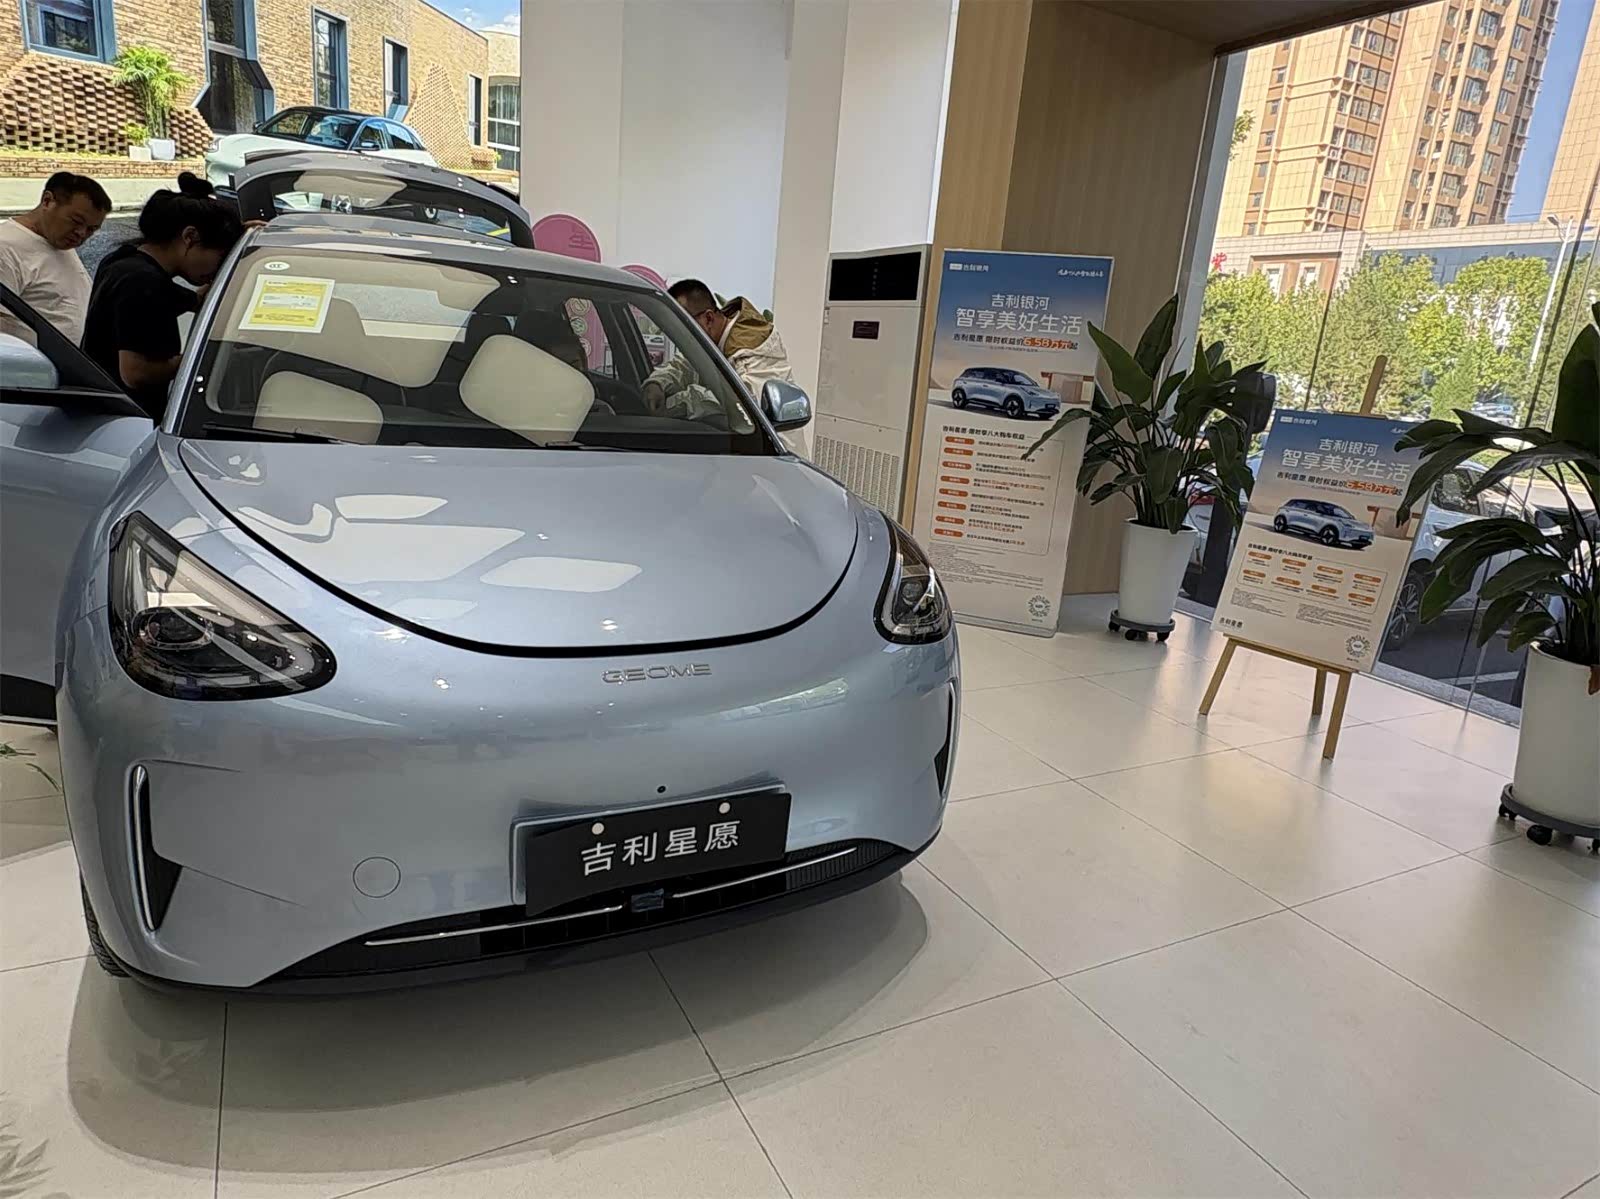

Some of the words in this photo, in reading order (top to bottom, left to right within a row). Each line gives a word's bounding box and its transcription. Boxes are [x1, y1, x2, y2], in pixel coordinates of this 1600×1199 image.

[991, 293, 1050, 311] 吉利银河
[956, 307, 1083, 336] 智享美好生活
[1319, 438, 1380, 457] 吉利银河
[1280, 448, 1411, 482] 智享美好生活
[602, 663, 713, 685] GEOME
[580, 819, 741, 877] 吉利星愿
